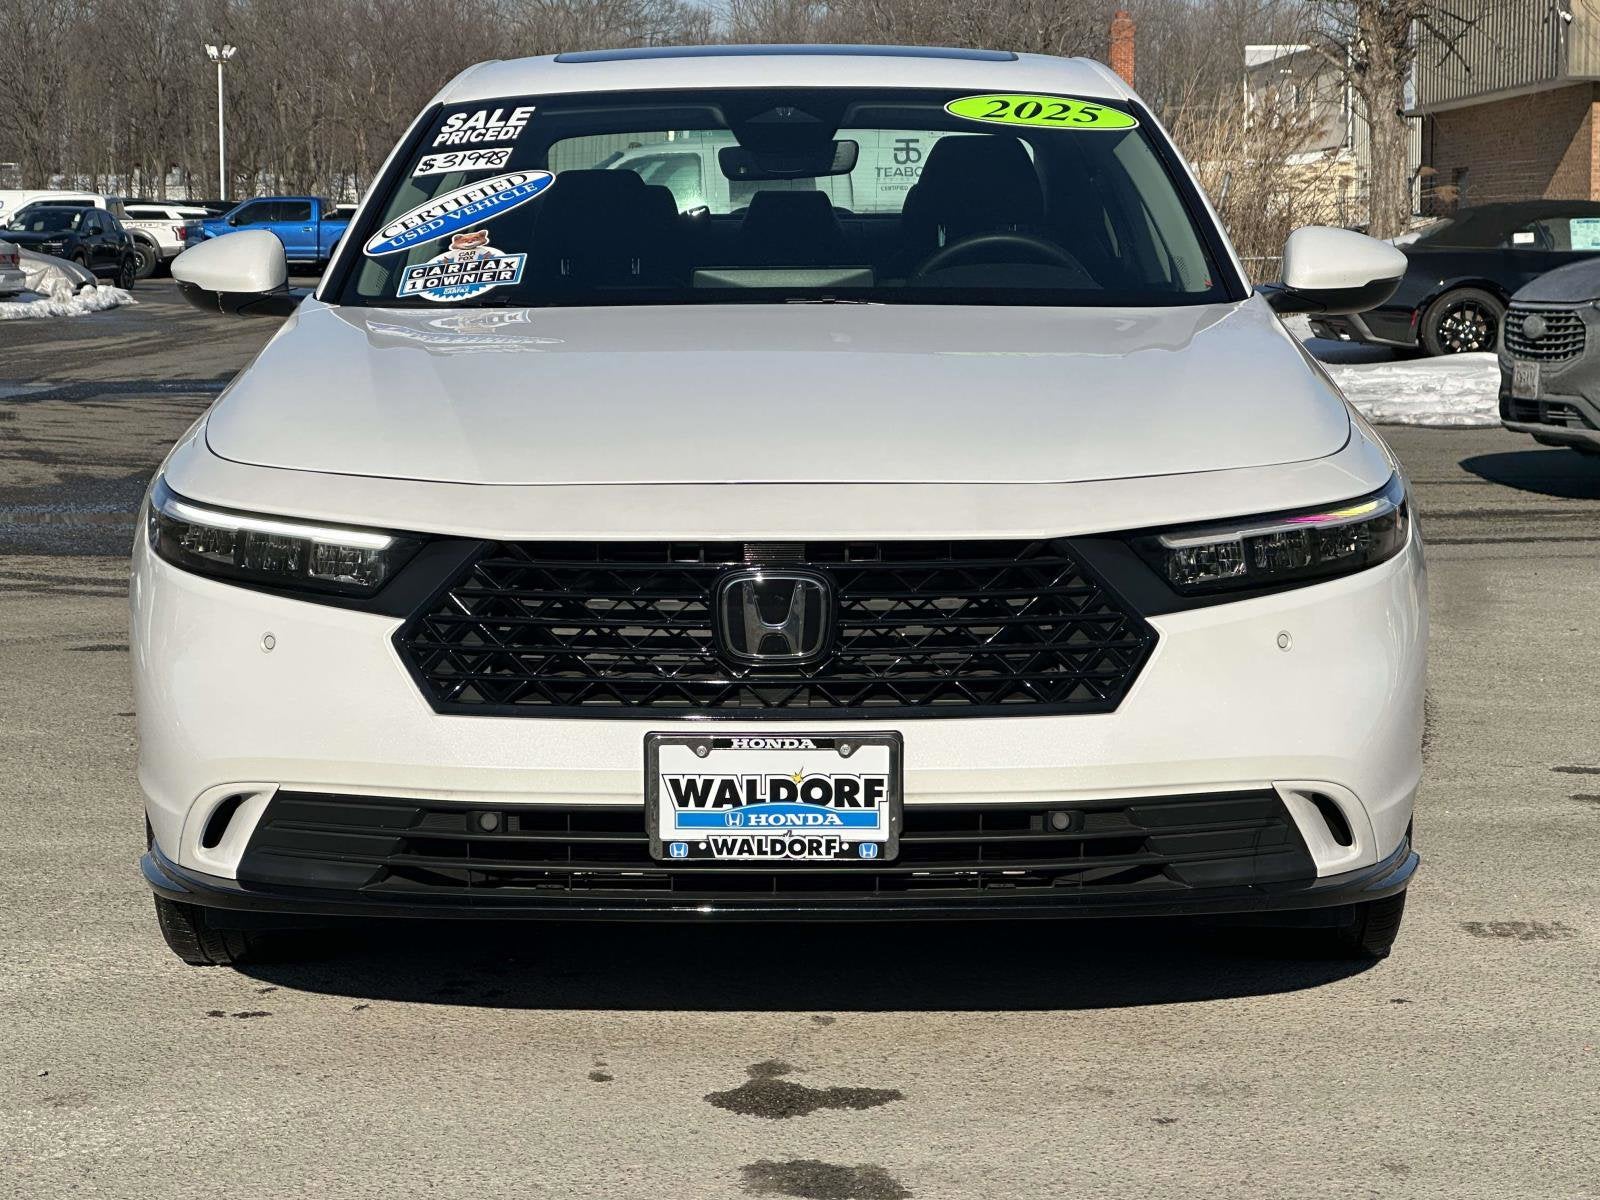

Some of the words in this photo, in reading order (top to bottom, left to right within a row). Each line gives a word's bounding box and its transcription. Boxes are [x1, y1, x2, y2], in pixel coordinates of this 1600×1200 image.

[441, 106, 536, 133] SALE
[980, 99, 1100, 123] 2025
[432, 126, 523, 147] PRICED!
[381, 174, 528, 239] CERTIFIED
[389, 219, 445, 247] USED
[447, 182, 538, 220] VEHICLE
[411, 259, 516, 278] CARFAX
[731, 738, 817, 749] HONDA
[669, 778, 884, 808] WALDORF
[748, 813, 843, 826] HONDA
[710, 838, 838, 856] WALDORF
